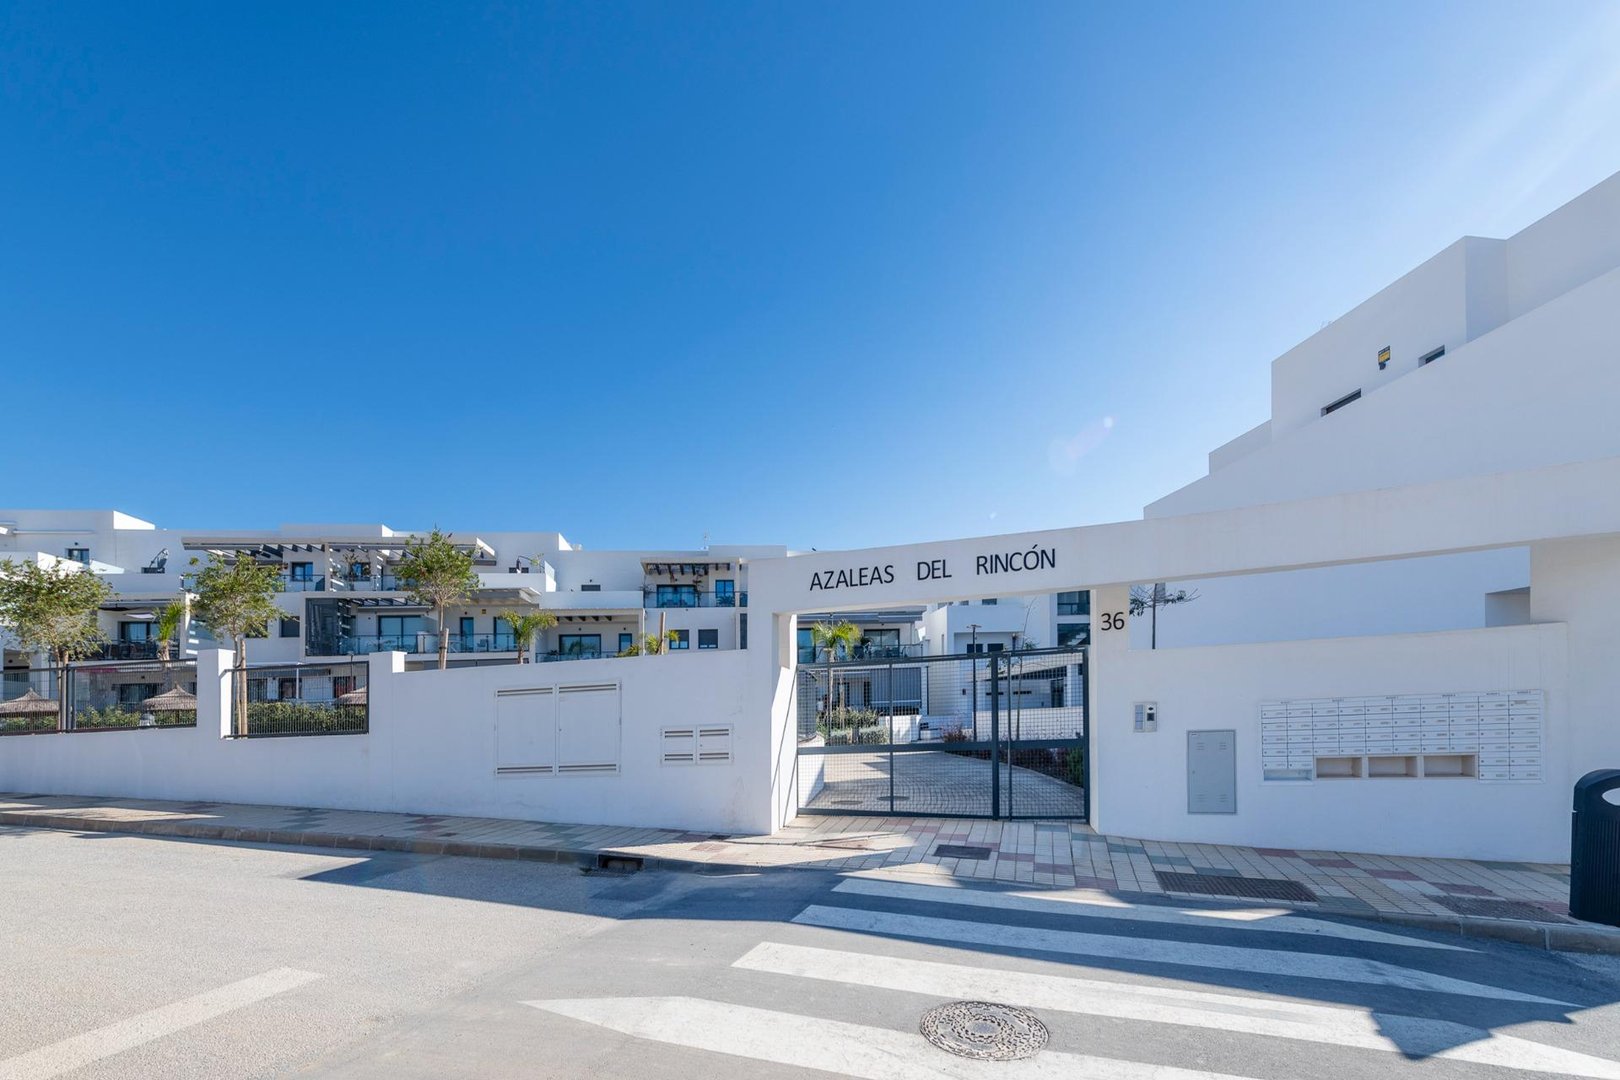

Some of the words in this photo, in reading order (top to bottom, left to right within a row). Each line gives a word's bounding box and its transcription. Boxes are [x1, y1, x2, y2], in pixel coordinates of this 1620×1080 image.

[809, 564, 895, 592] AZALEAS
[916, 558, 953, 581] DEL
[976, 544, 1056, 576] RINCÓN
[1100, 611, 1125, 632] 36
